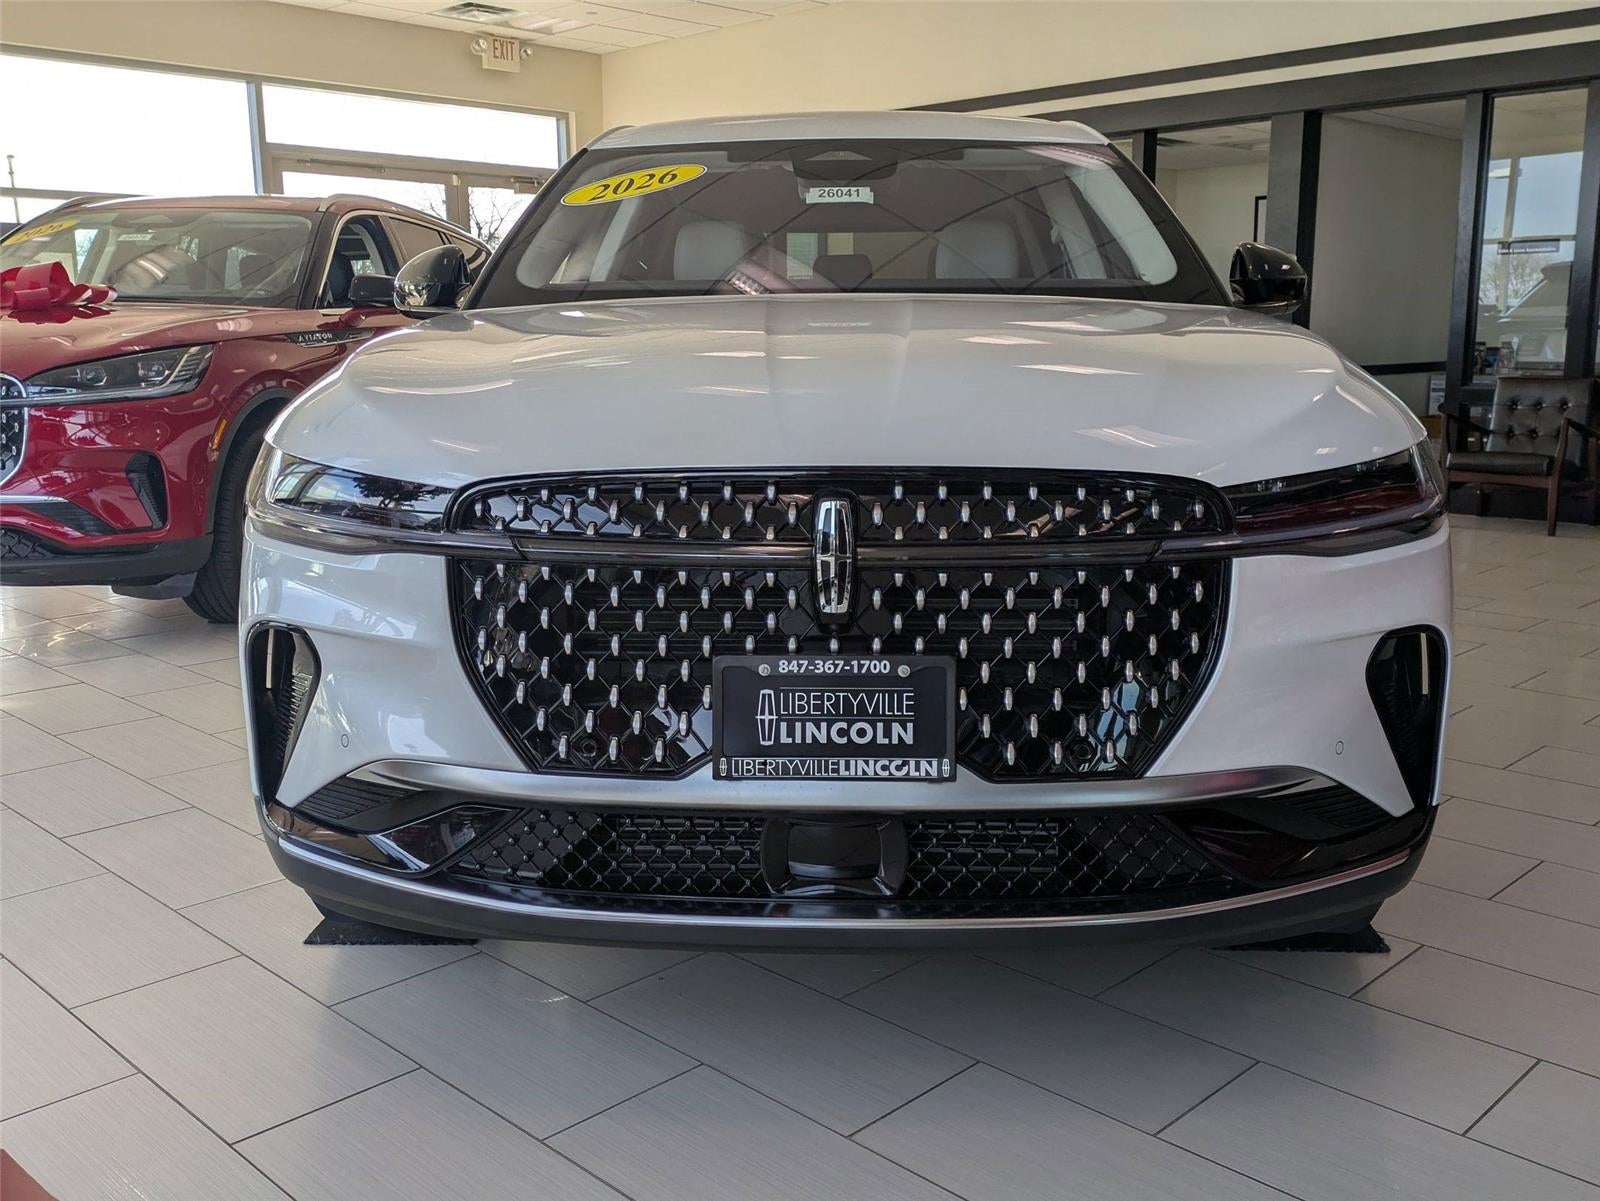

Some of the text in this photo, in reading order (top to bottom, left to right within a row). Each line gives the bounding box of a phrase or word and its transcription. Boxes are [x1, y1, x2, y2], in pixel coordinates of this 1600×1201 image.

[493, 39, 515, 61] EXIT
[587, 167, 680, 202] 2026
[817, 188, 861, 199] 26041
[778, 659, 891, 675] 847-367-1700
[780, 692, 915, 716] LIBERTYVILLE
[780, 721, 914, 745] LINCOLN
